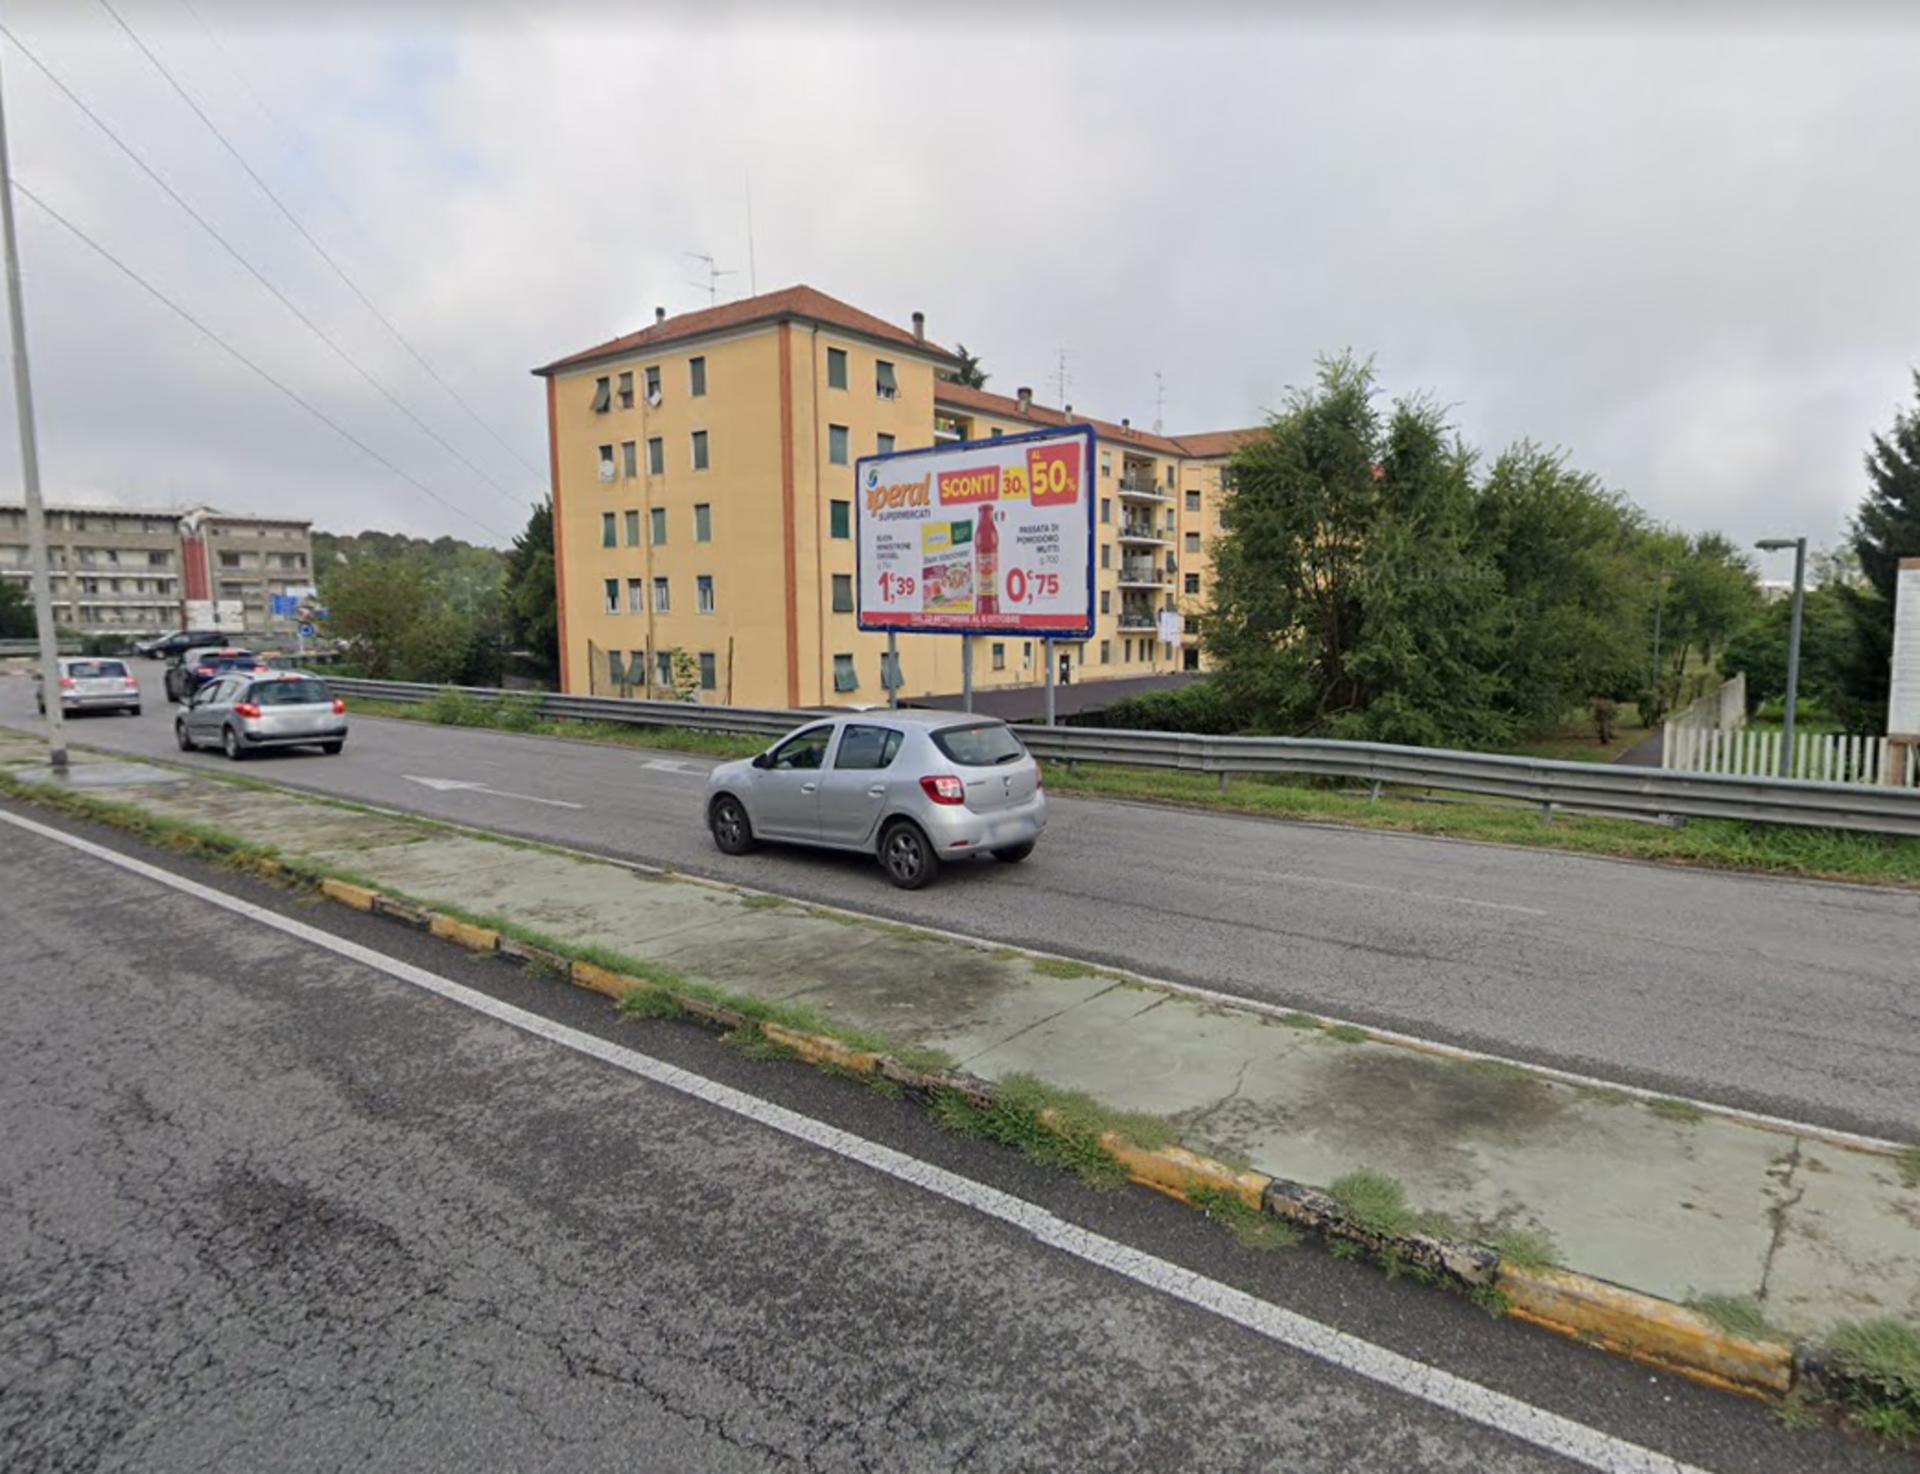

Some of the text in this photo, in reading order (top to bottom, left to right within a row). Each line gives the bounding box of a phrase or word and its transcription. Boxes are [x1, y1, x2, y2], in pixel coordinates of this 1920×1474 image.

[1031, 459, 1077, 495] 50%
[941, 473, 996, 498] SCONTI
[878, 509, 931, 521] SUPERMERCATI
[1019, 523, 1059, 533] PASSATA DI
[1016, 534, 1060, 544] POMODORO
[1036, 544, 1060, 553] MUTTI
